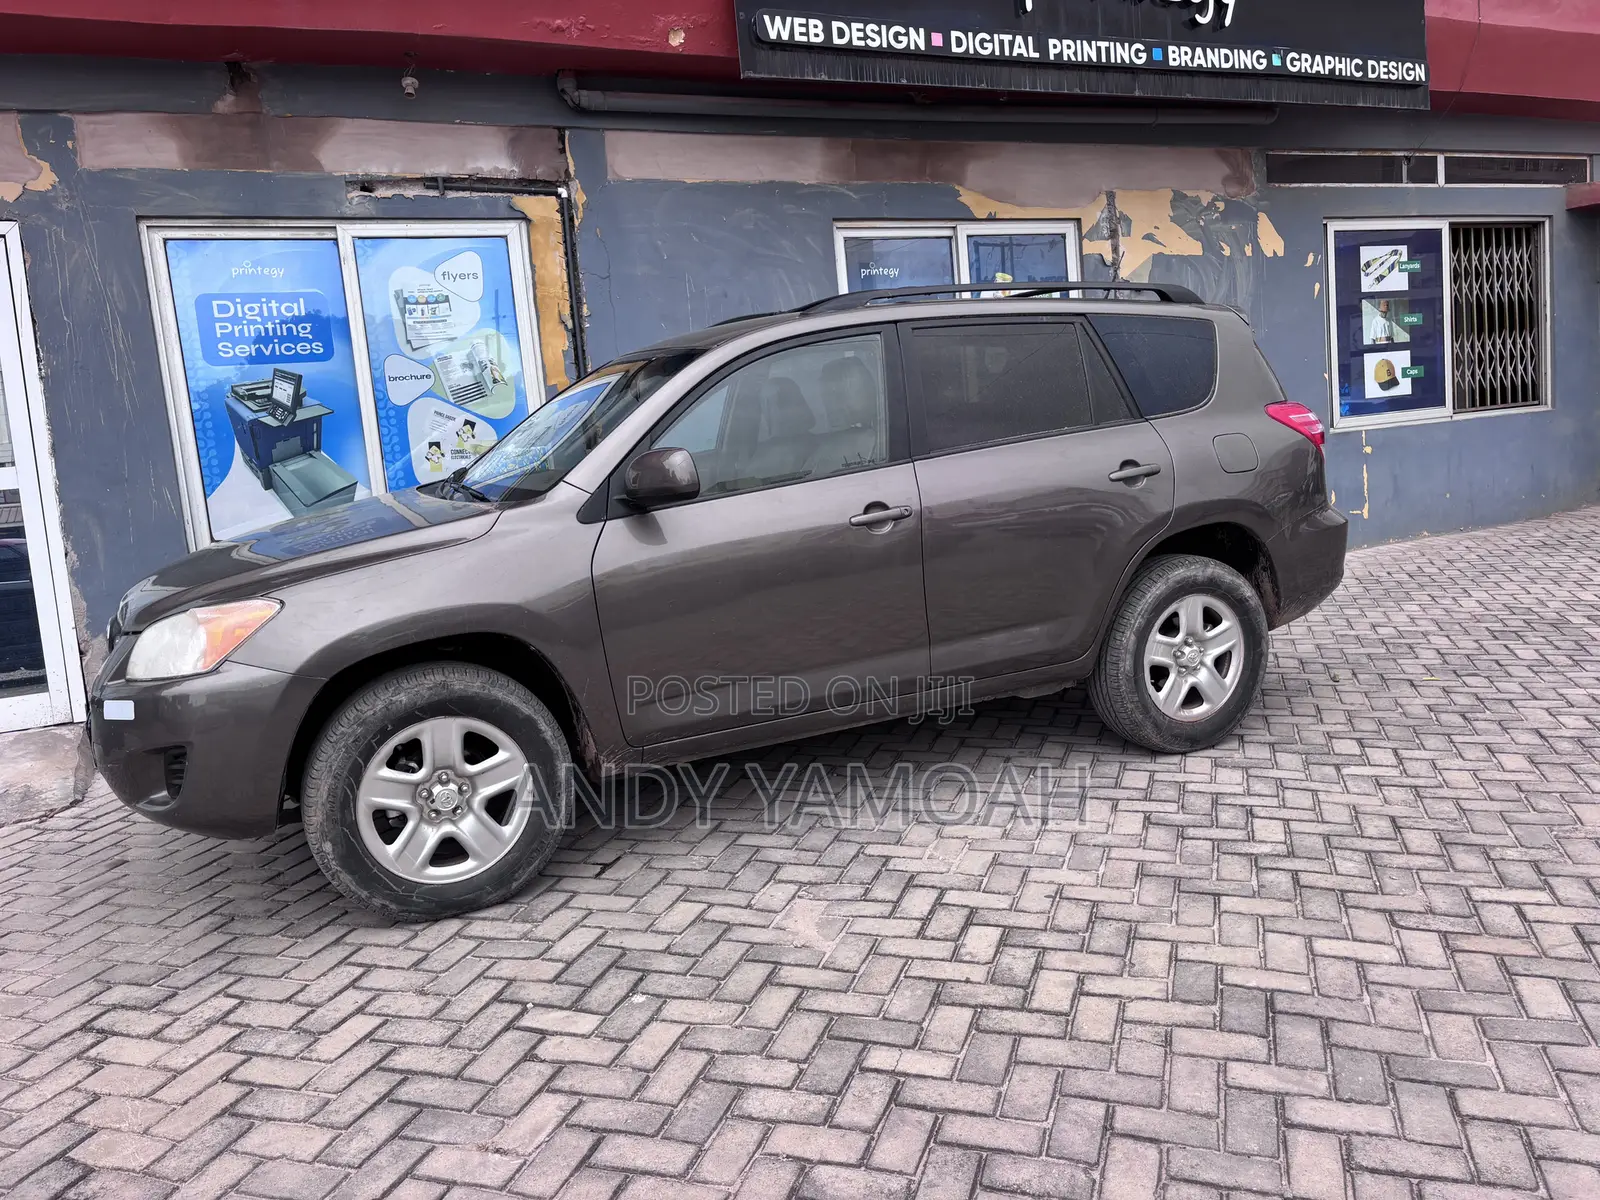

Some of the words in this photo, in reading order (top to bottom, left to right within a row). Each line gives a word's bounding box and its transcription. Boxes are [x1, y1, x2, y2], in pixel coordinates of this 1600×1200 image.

[763, 15, 825, 43] WEB
[831, 20, 925, 51] DESIGN
[950, 30, 1040, 58] DIGITAL
[1048, 38, 1147, 65] PRINTING
[1167, 45, 1267, 70] BRANDING
[1286, 53, 1363, 78] GRAPHIC
[1367, 60, 1426, 82] DESIGN
[231, 260, 285, 278] printegy
[860, 261, 900, 279] printegy
[1399, 262, 1420, 270] Lanyards
[441, 271, 479, 283] flyers
[211, 298, 306, 322] Digital
[215, 319, 313, 339] Printing
[217, 339, 324, 358] Services
[388, 373, 432, 382] brochure
